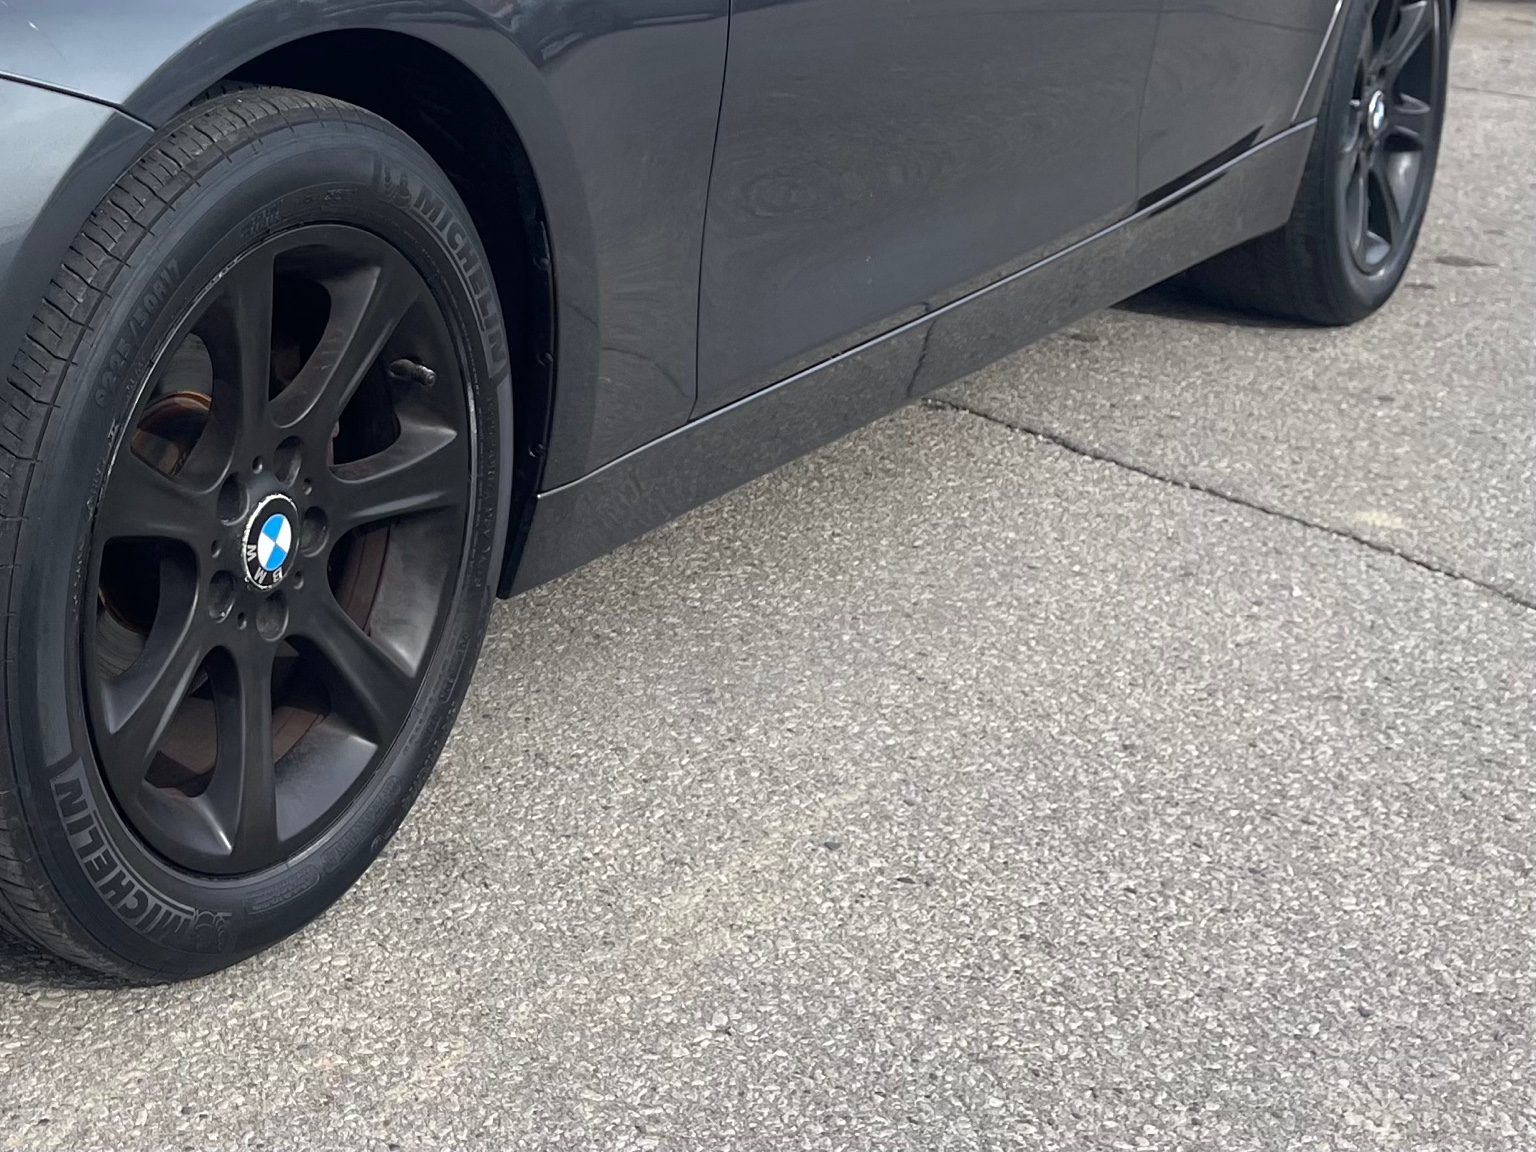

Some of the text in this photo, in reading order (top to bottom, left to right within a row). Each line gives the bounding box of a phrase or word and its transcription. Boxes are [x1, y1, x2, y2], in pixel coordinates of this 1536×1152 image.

[413, 184, 507, 372] MICHELIN
[246, 544, 284, 585] BMW
[54, 777, 192, 939] MICHELIN
